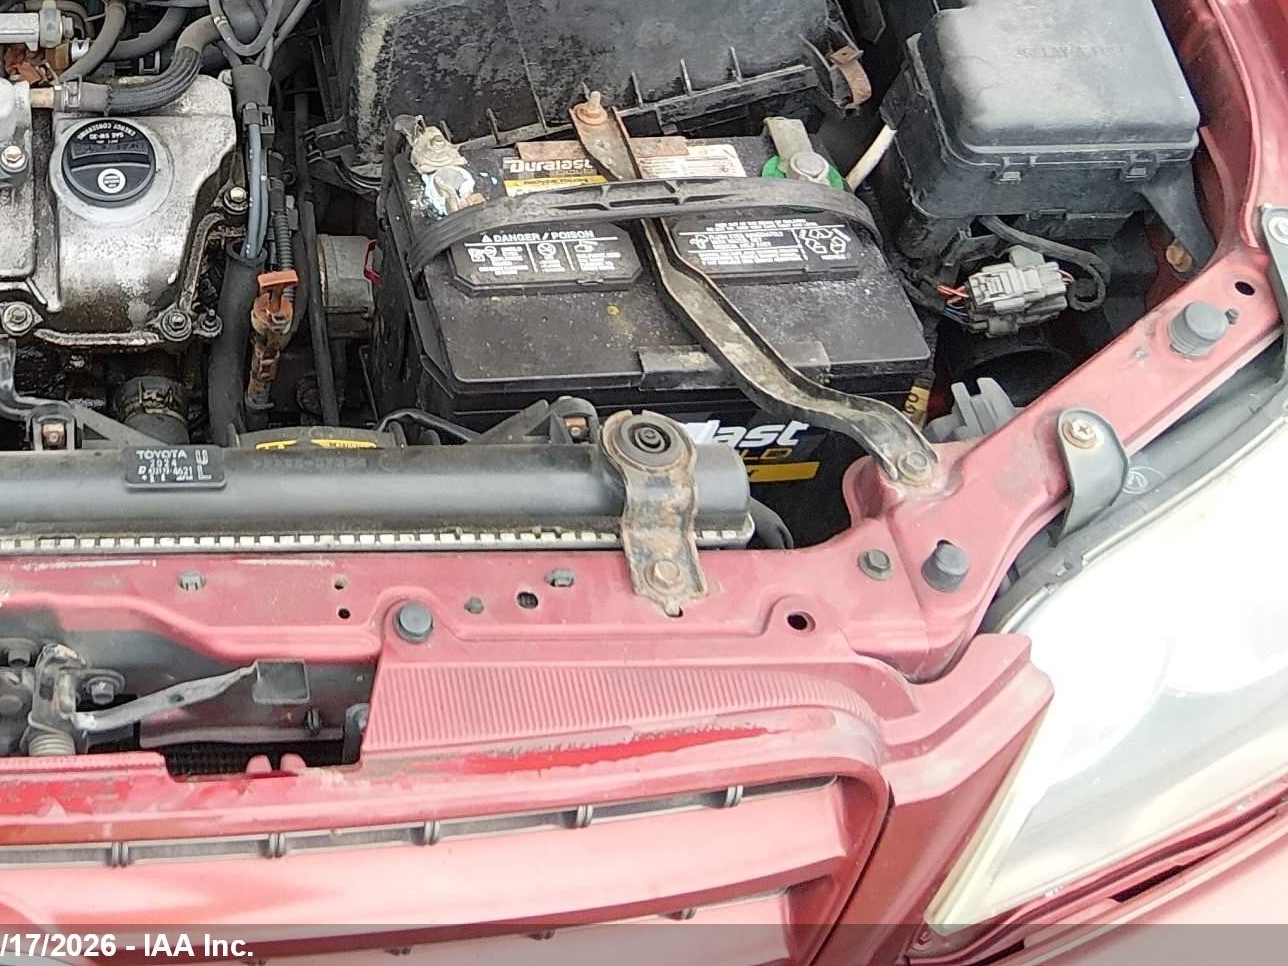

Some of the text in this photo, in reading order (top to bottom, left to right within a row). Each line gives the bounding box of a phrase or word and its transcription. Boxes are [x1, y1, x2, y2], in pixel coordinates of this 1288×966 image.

[504, 156, 593, 173] Duralast
[493, 233, 541, 243] DANGER
[551, 230, 595, 240] POISON
[136, 449, 188, 460] TOYOTA
